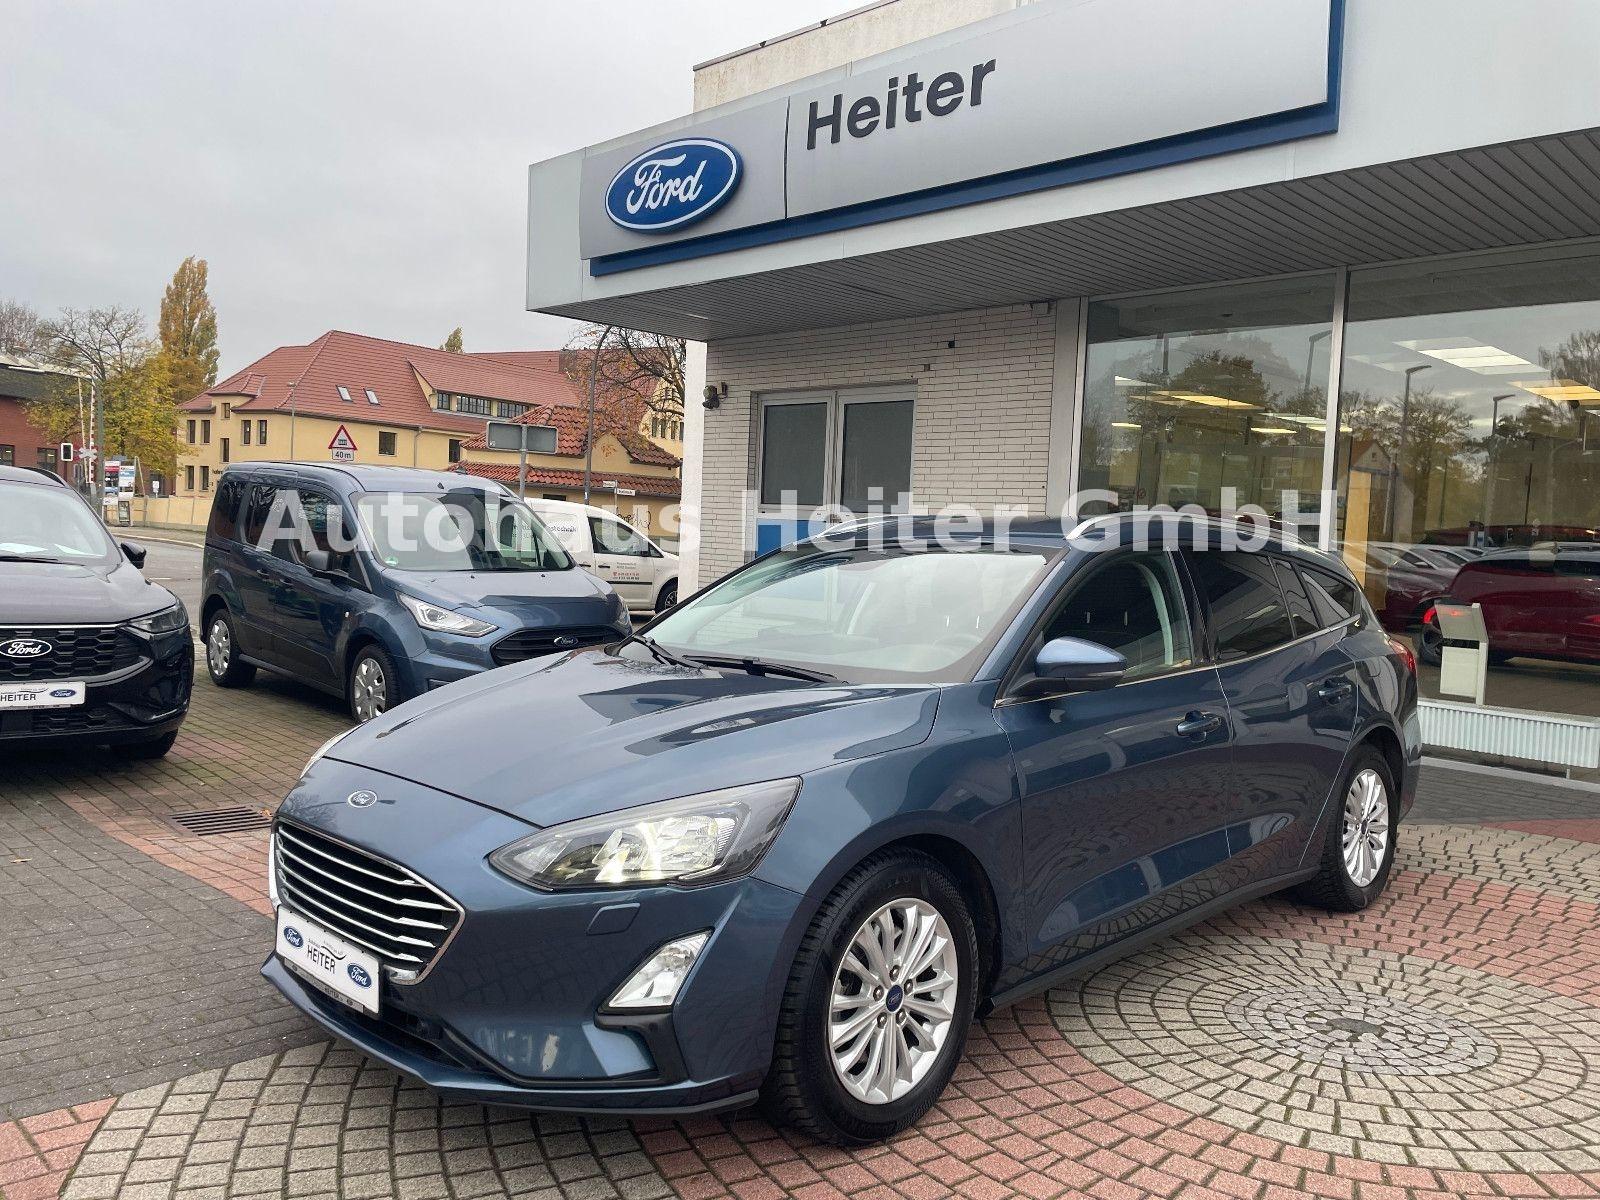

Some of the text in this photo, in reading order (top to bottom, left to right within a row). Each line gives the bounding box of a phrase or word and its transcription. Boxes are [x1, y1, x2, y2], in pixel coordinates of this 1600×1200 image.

[806, 59, 997, 151] Heiter
[626, 153, 707, 214] Ford
[335, 451, 344, 459] 40
[7, 641, 42, 655] Ford
[0, 693, 36, 702] HEITER
[286, 928, 301, 946] Ford
[306, 944, 336, 975] HEITER
[351, 966, 368, 986] Ford
